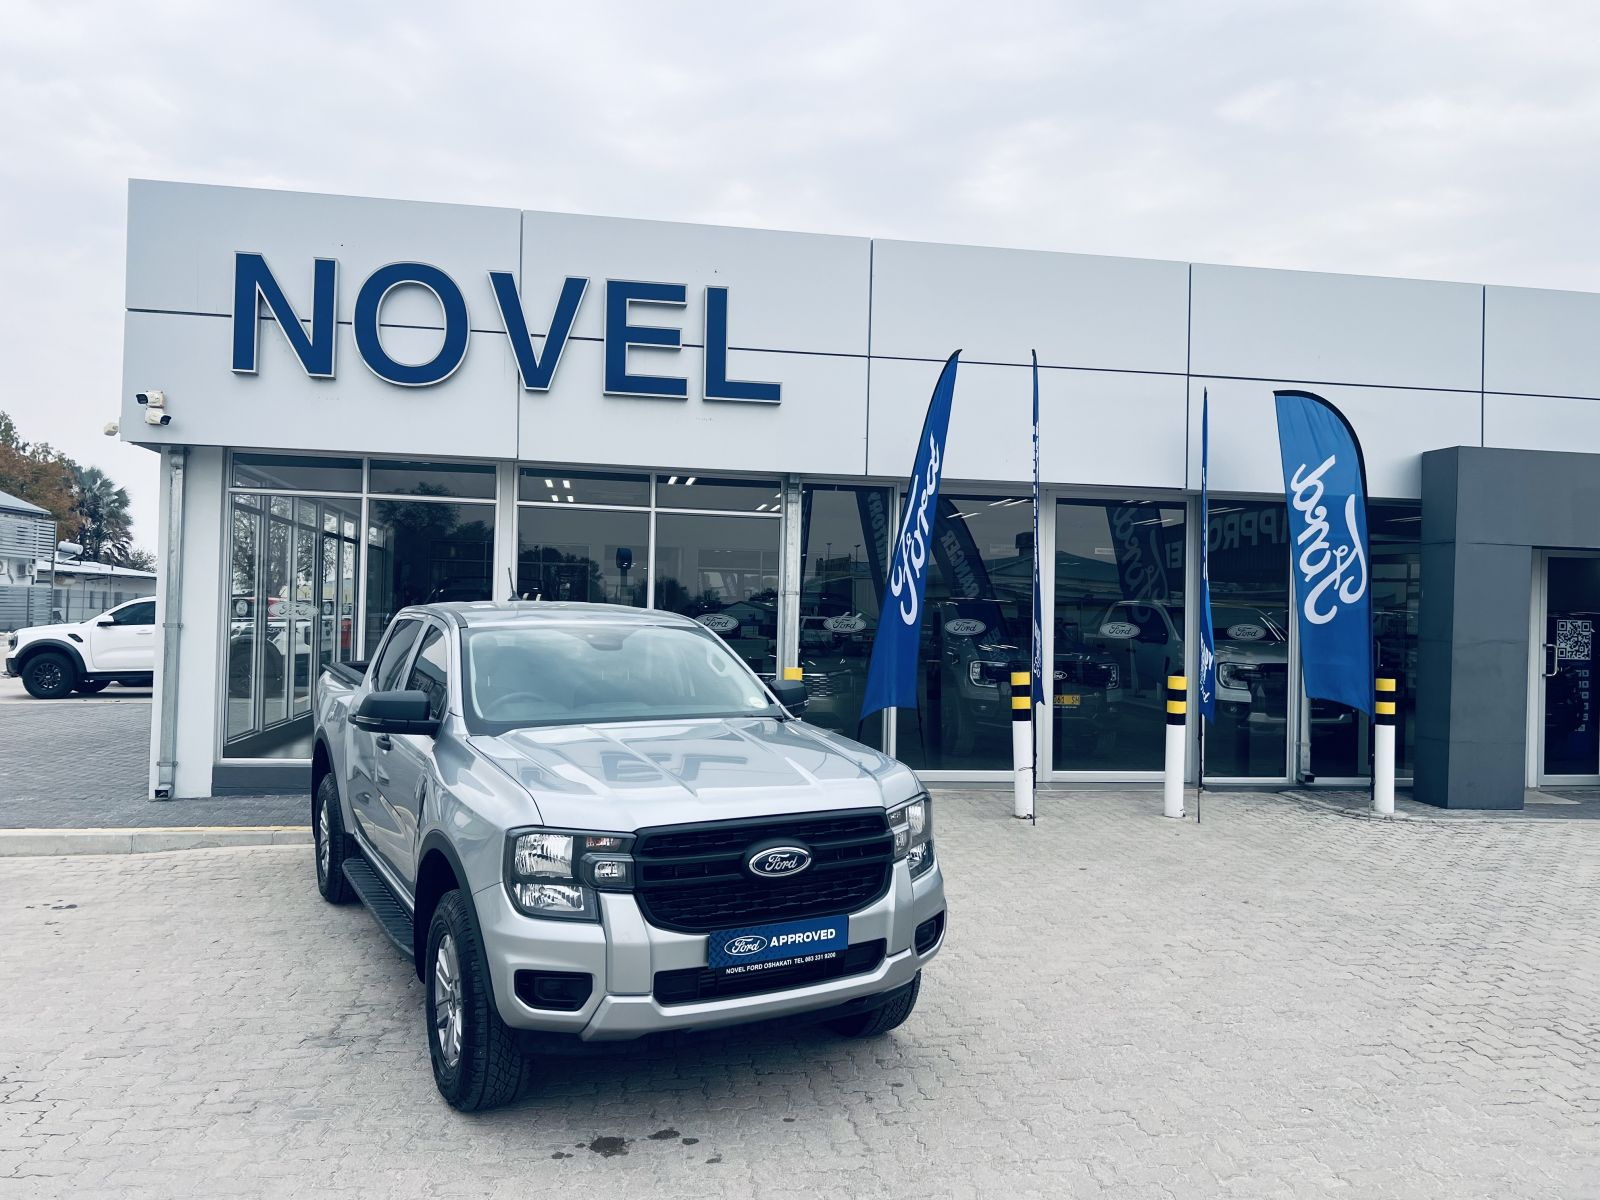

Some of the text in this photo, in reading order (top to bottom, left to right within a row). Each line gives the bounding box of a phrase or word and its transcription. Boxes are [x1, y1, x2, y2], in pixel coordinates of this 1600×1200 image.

[231, 251, 782, 404] NOVEL
[891, 431, 939, 626] Ford
[703, 616, 729, 628] Ford
[831, 618, 858, 631] Ford
[953, 619, 977, 632] Ford
[1108, 624, 1133, 636] Ford
[1234, 626, 1259, 638] Ford
[765, 853, 798, 871] Ford
[731, 929, 836, 954] Ford APPROVED
[726, 966, 746, 974] NOVEL
[746, 962, 763, 972] FORD
[763, 959, 792, 969] OSHAKATI
